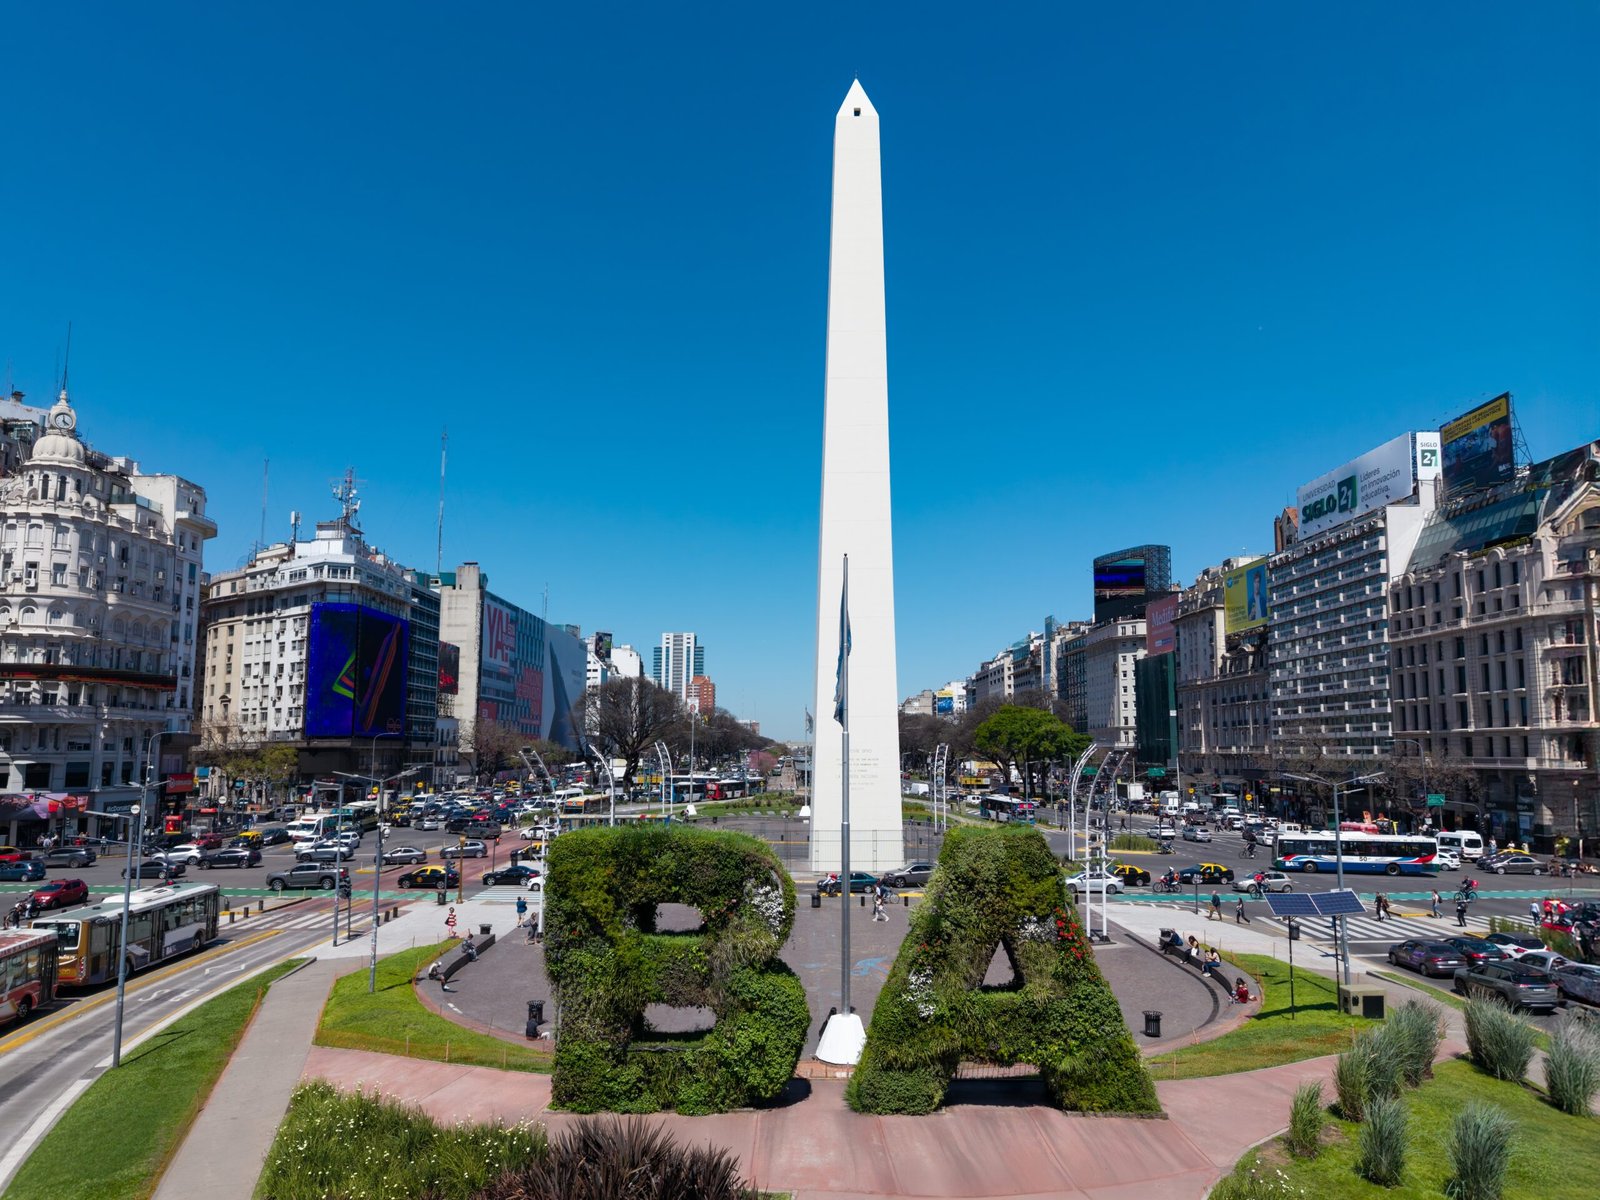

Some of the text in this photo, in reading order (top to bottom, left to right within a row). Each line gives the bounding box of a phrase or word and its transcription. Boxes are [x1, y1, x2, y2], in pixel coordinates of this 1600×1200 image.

[1423, 452, 1436, 466] 21
[1302, 479, 1336, 501] UNIVERSIDAD
[1360, 469, 1400, 493] en innovación
[1302, 493, 1337, 524] SIGLO
